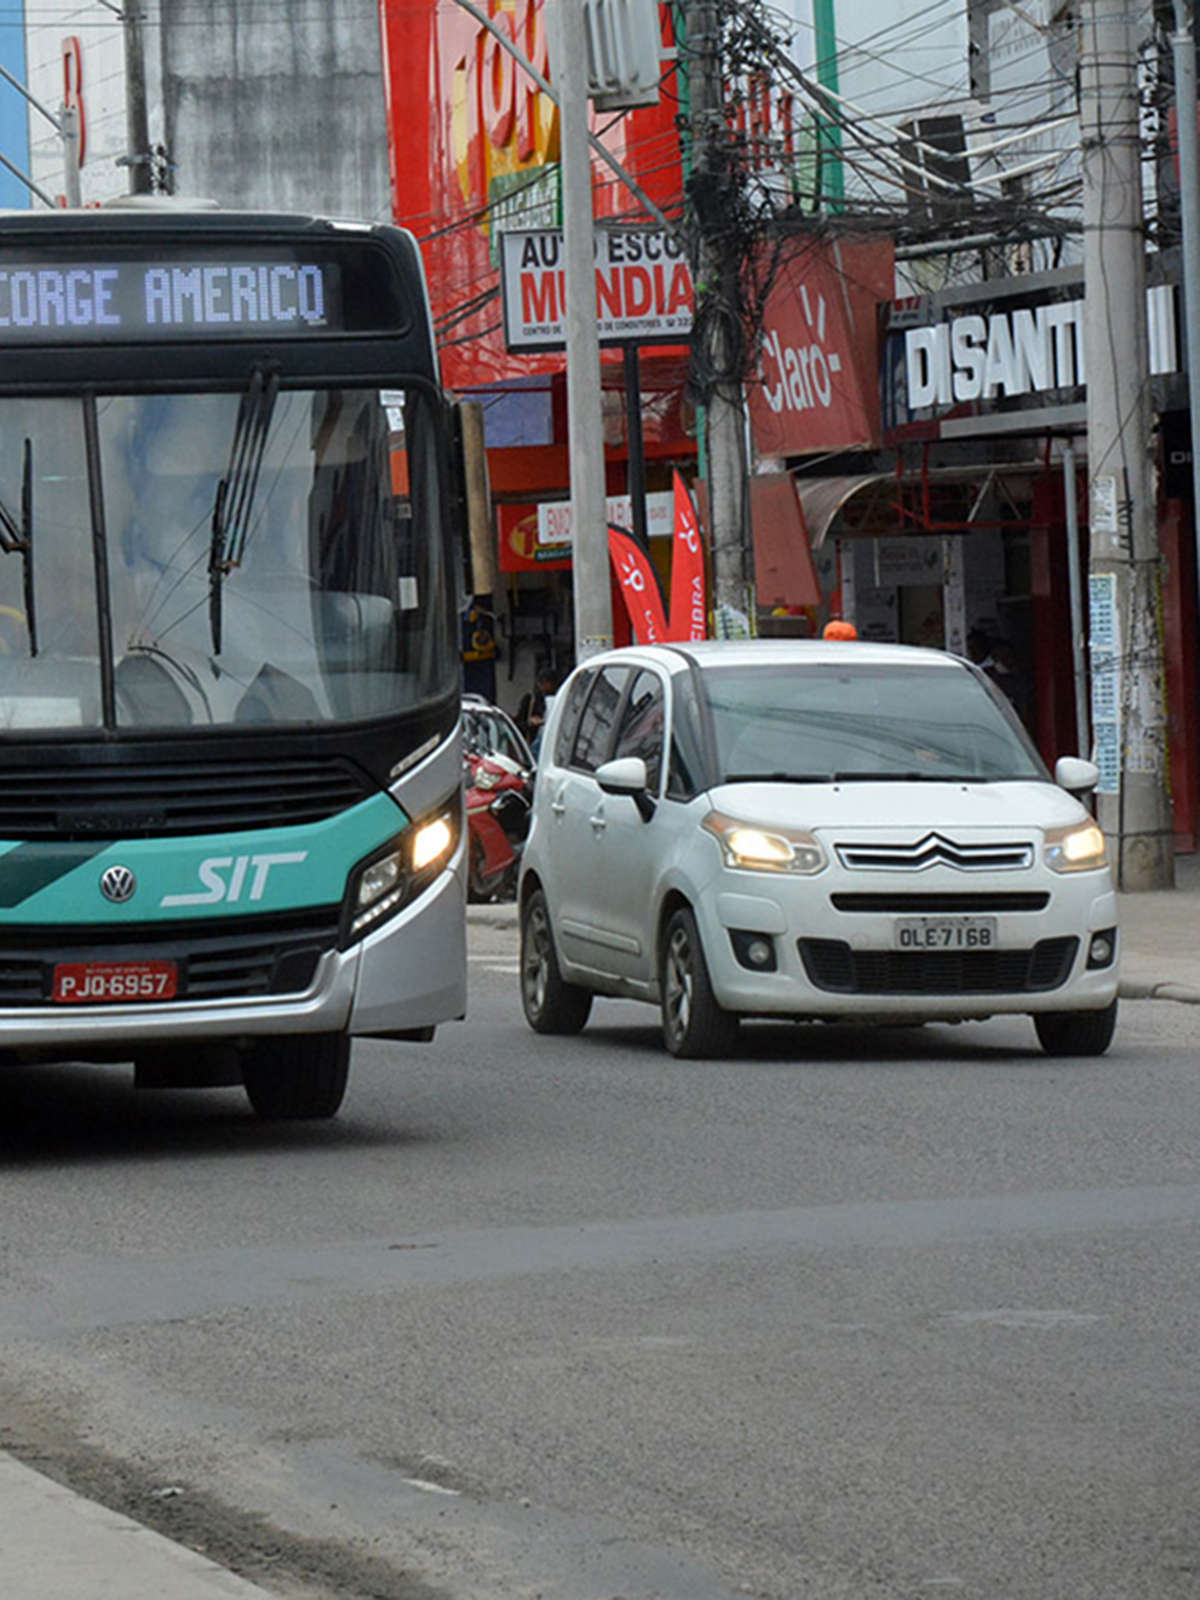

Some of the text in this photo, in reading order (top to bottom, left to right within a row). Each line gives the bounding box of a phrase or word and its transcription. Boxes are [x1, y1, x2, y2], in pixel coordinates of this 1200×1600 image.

[521, 233, 598, 268] AU
[144, 264, 324, 323] AMERICO
[520, 263, 694, 324] MNDIA
[757, 328, 833, 413] Claro
[160, 850, 308, 907] SIT
